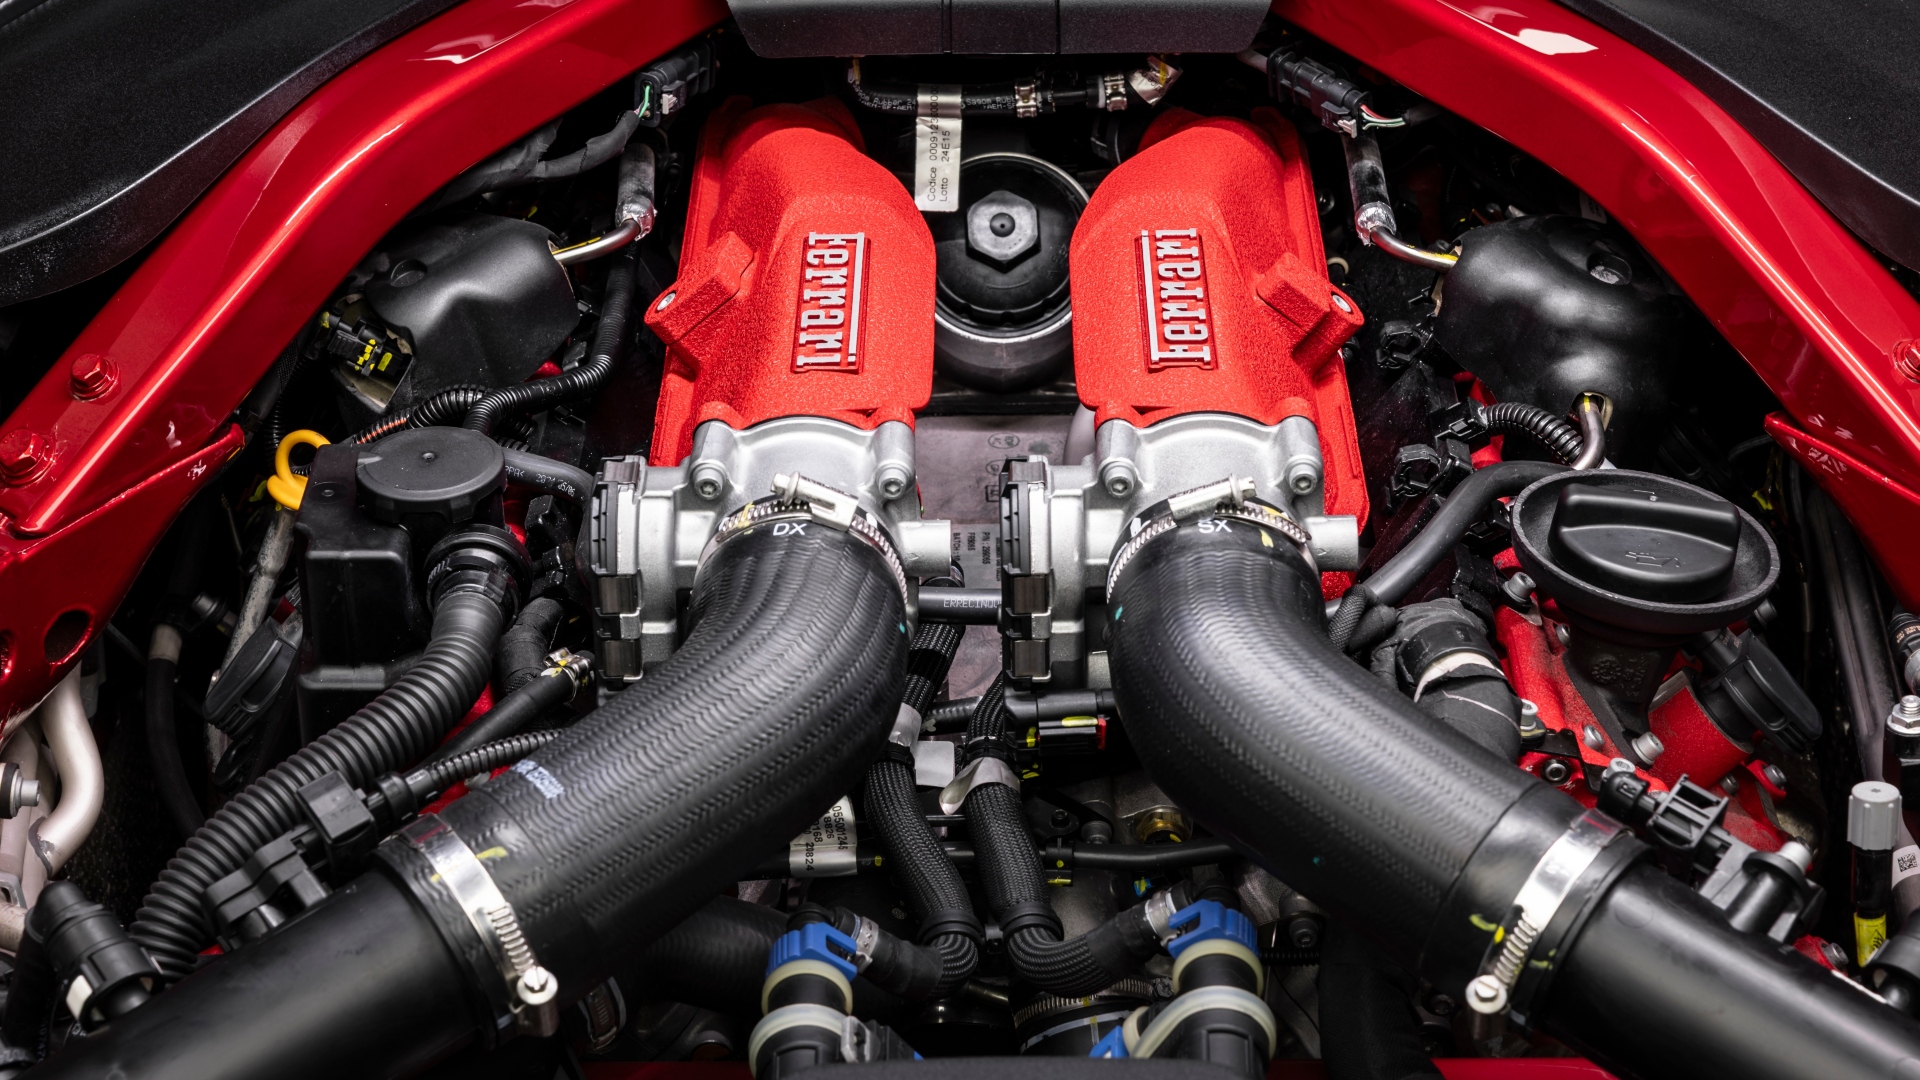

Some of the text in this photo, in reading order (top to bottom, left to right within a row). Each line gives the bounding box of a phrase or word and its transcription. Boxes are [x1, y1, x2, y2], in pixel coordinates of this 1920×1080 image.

[873, 97, 903, 106] Rubber
[965, 97, 993, 106] Sagom
[940, 130, 951, 202] Lotto 24E15
[927, 166, 938, 202] Codice
[796, 231, 866, 367] Ferrari
[1141, 227, 1212, 363] Ferrari
[772, 522, 808, 537] DX
[1197, 518, 1233, 534] SX
